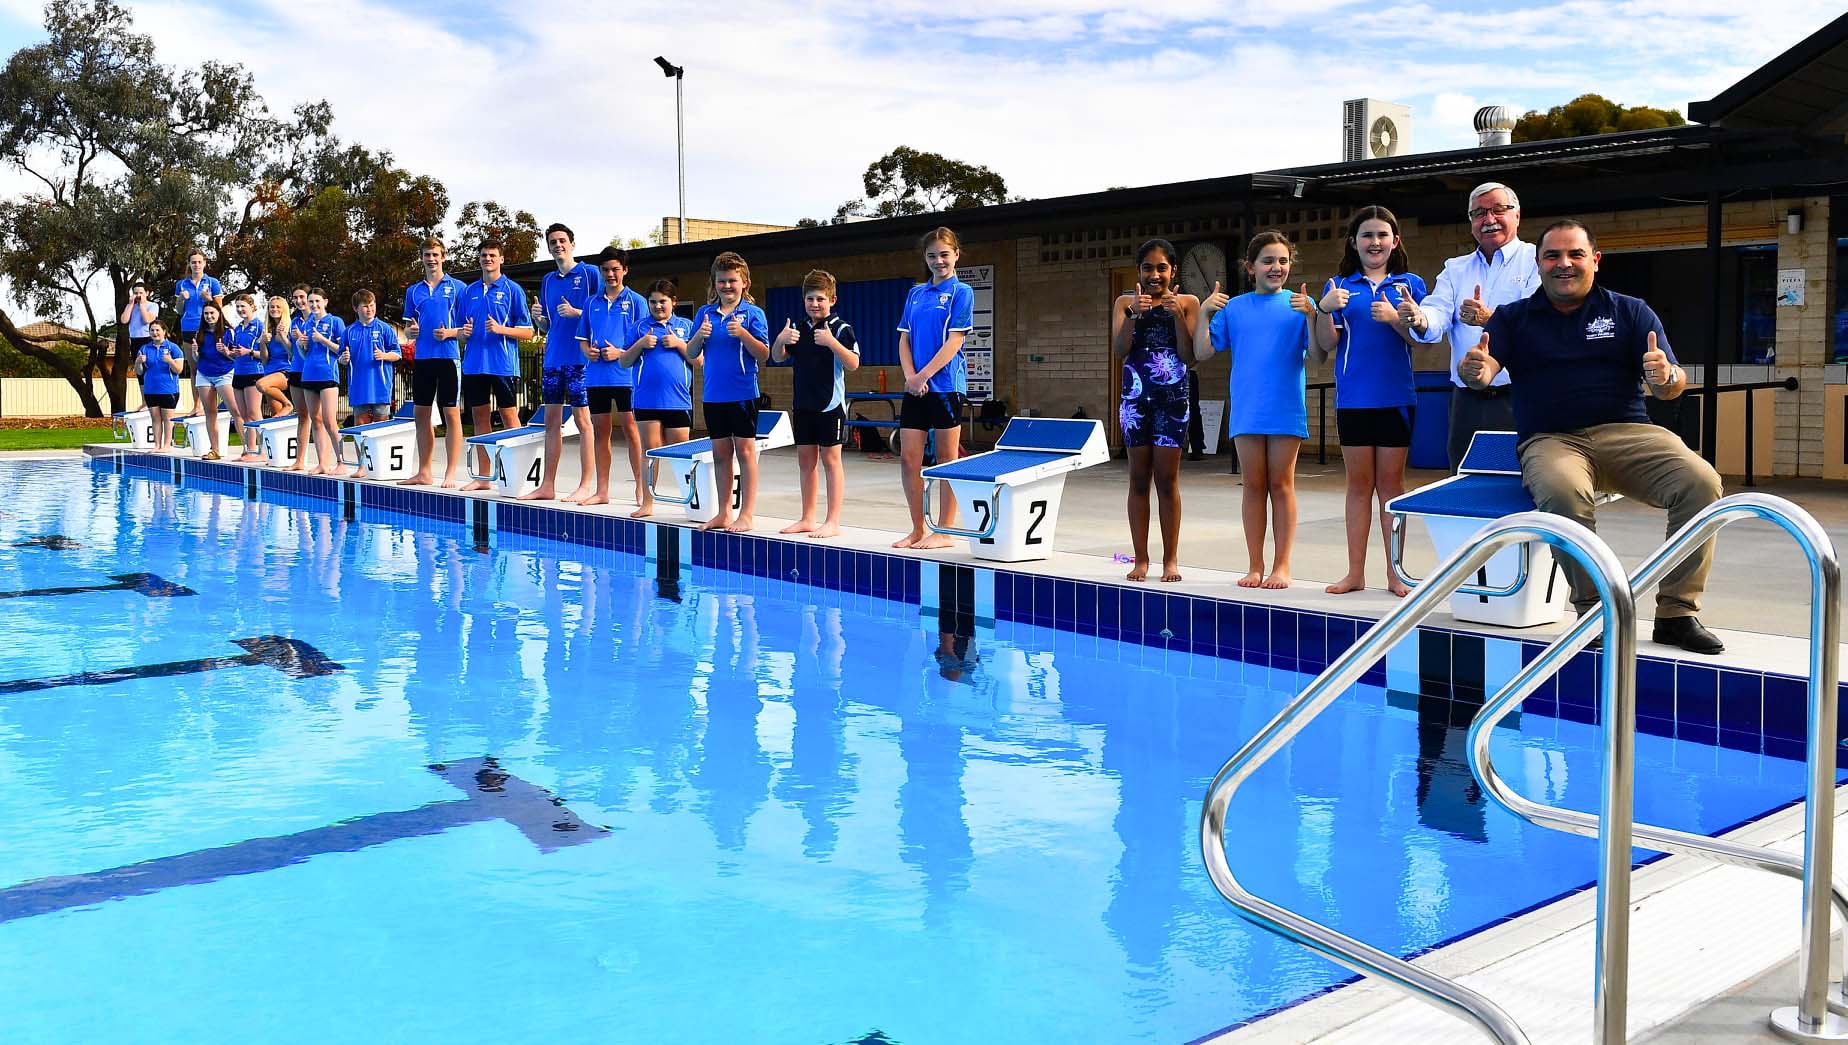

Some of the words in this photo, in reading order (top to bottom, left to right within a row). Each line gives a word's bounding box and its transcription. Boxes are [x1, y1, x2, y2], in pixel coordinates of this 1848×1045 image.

[390, 445, 403, 471] 5
[526, 457, 541, 487] 4
[973, 500, 995, 544] 2
[1025, 500, 1047, 545] 2
